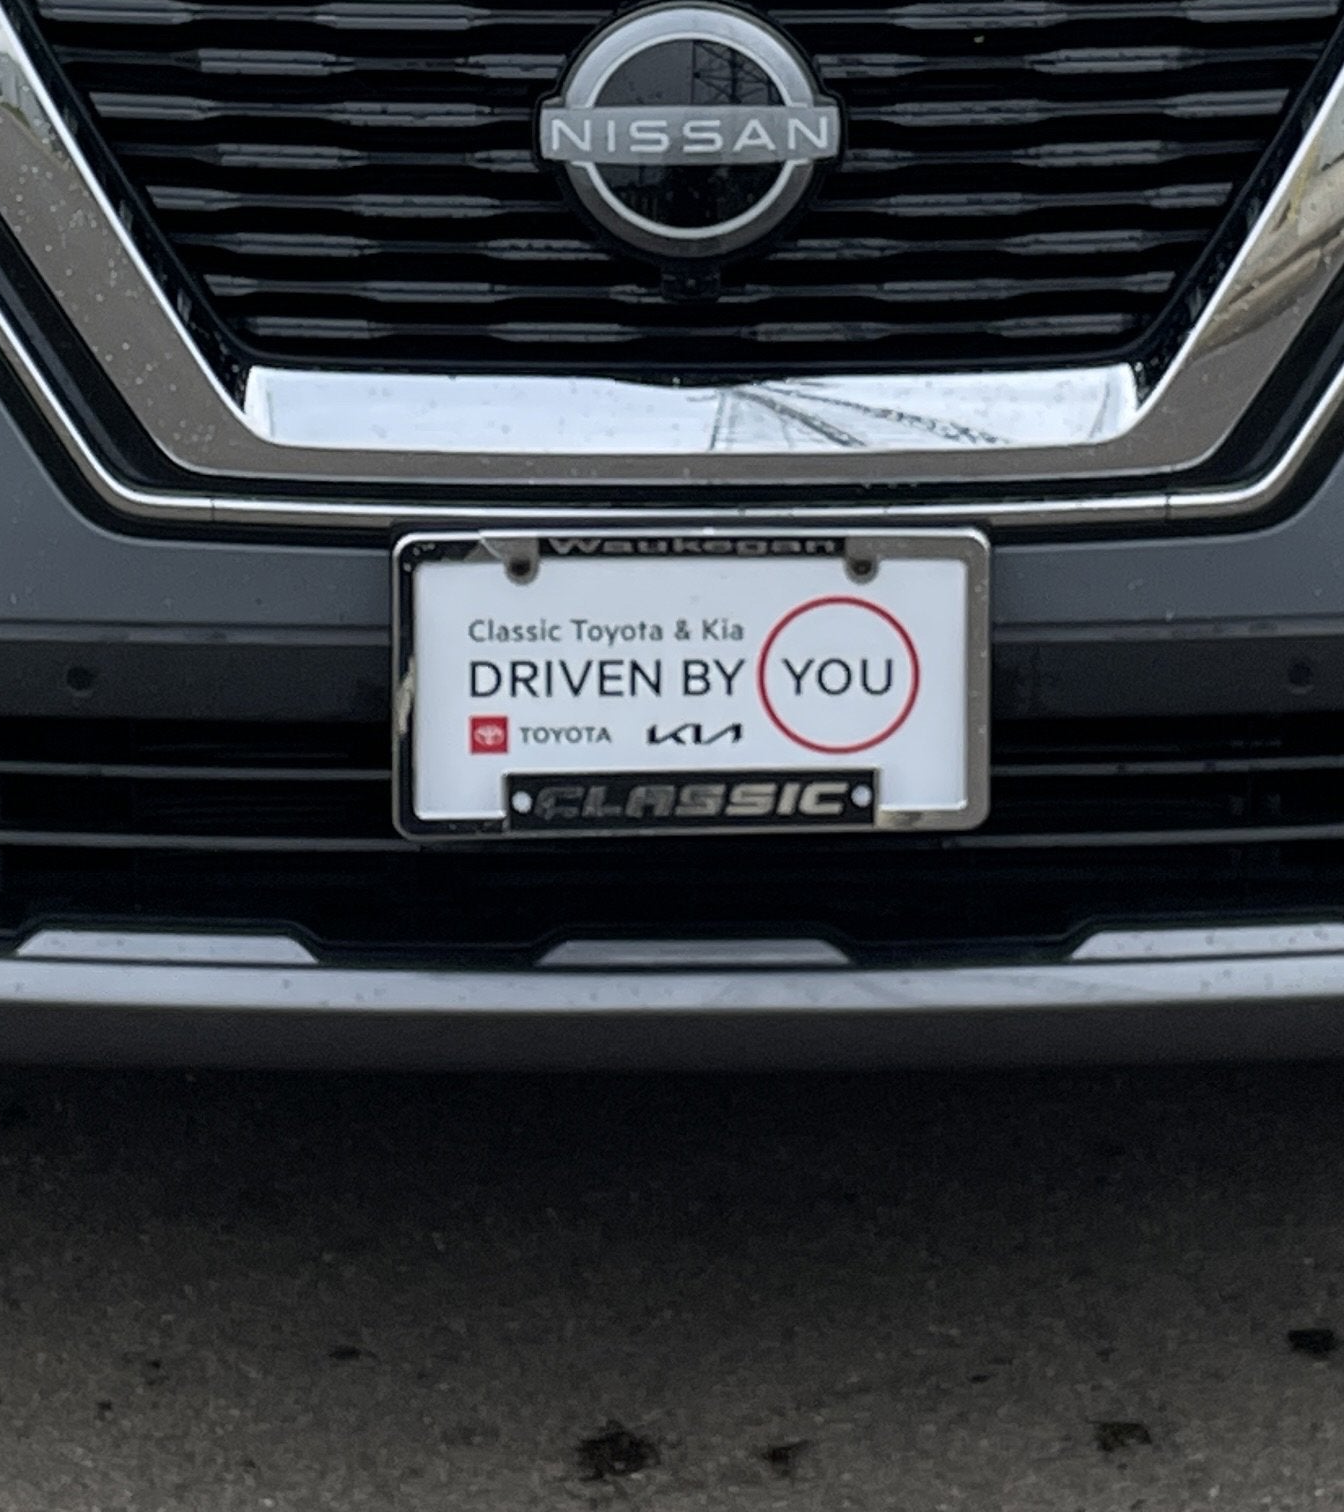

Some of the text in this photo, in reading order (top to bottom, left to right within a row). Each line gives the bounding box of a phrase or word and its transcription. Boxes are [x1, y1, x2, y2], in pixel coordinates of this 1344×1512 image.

[551, 115, 828, 154] NISSAN
[548, 537, 835, 556] Waukegan
[468, 618, 745, 649] Classic Toyota & Kia
[469, 657, 893, 698] DRIVEN BY YOU
[520, 726, 612, 745] TOYOTA
[533, 782, 849, 819] CLASSIC
